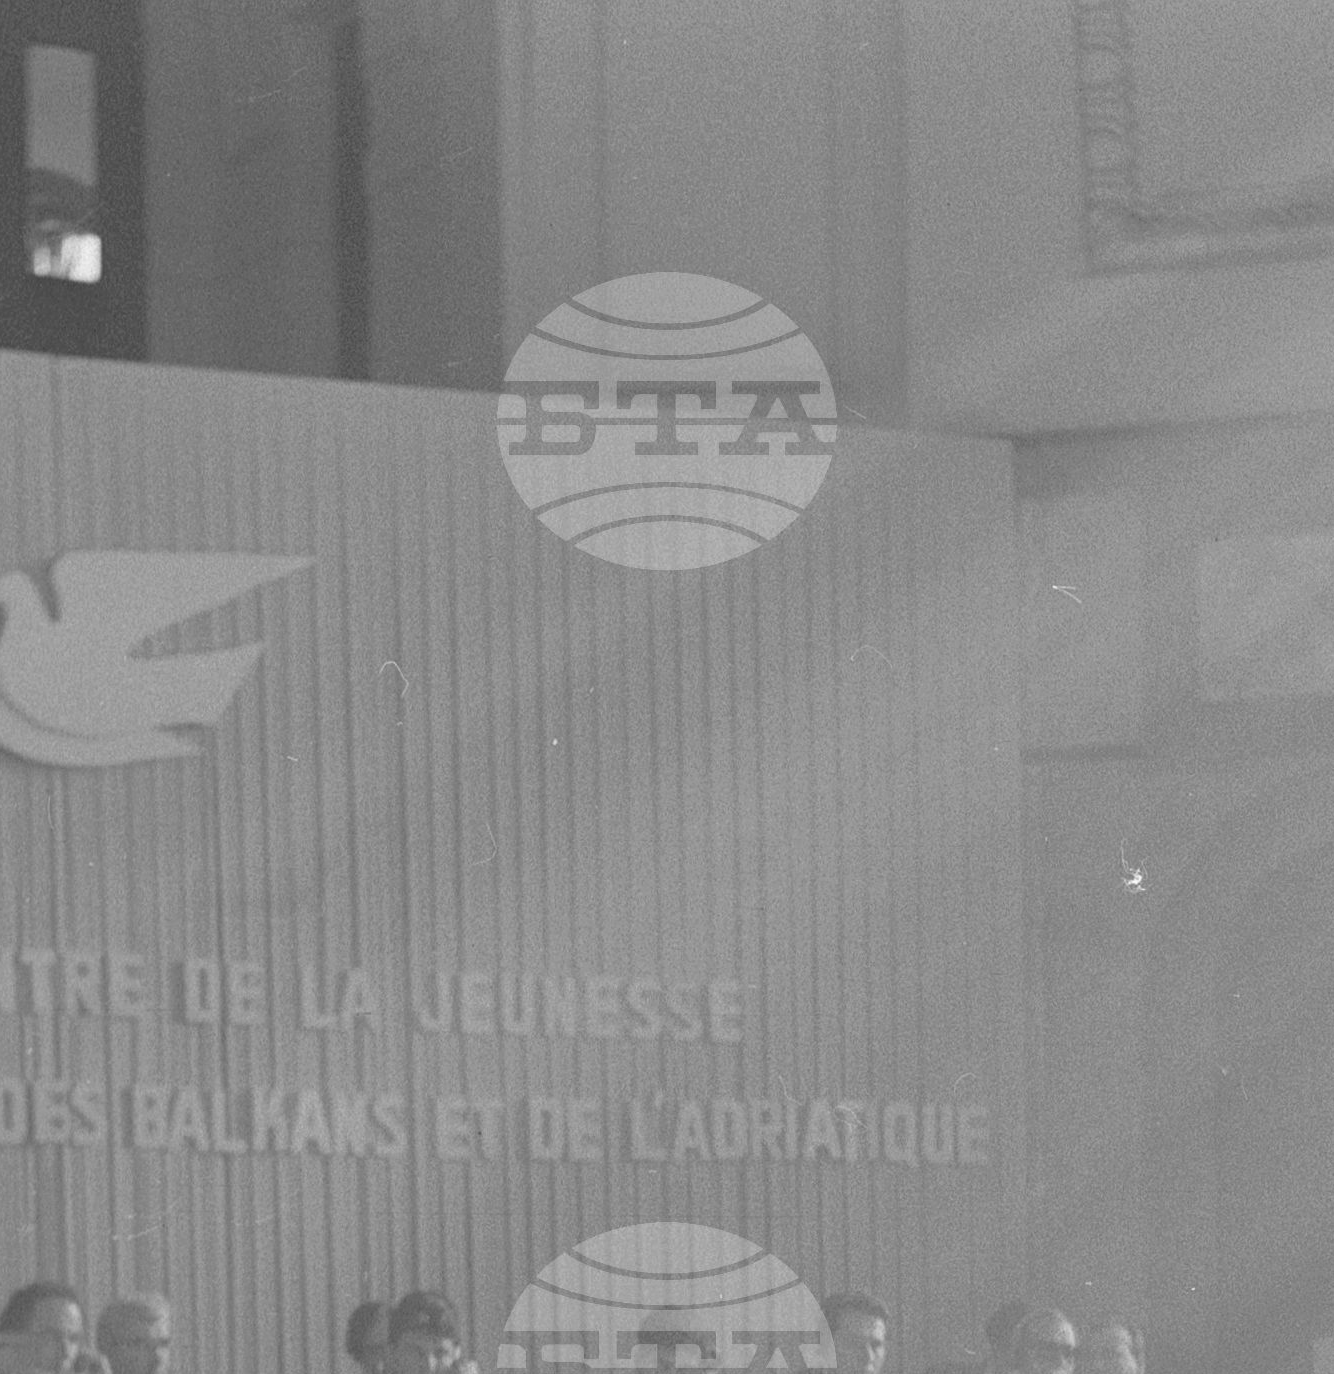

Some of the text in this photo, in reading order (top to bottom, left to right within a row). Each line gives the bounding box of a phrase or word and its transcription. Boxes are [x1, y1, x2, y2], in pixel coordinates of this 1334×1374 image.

[184, 956, 267, 1026] DE
[301, 962, 377, 1032] LA
[417, 972, 743, 1043] JEUNESSE
[133, 1083, 408, 1159] BALKANS
[435, 1095, 504, 1162] ET
[530, 1098, 603, 1161] DE
